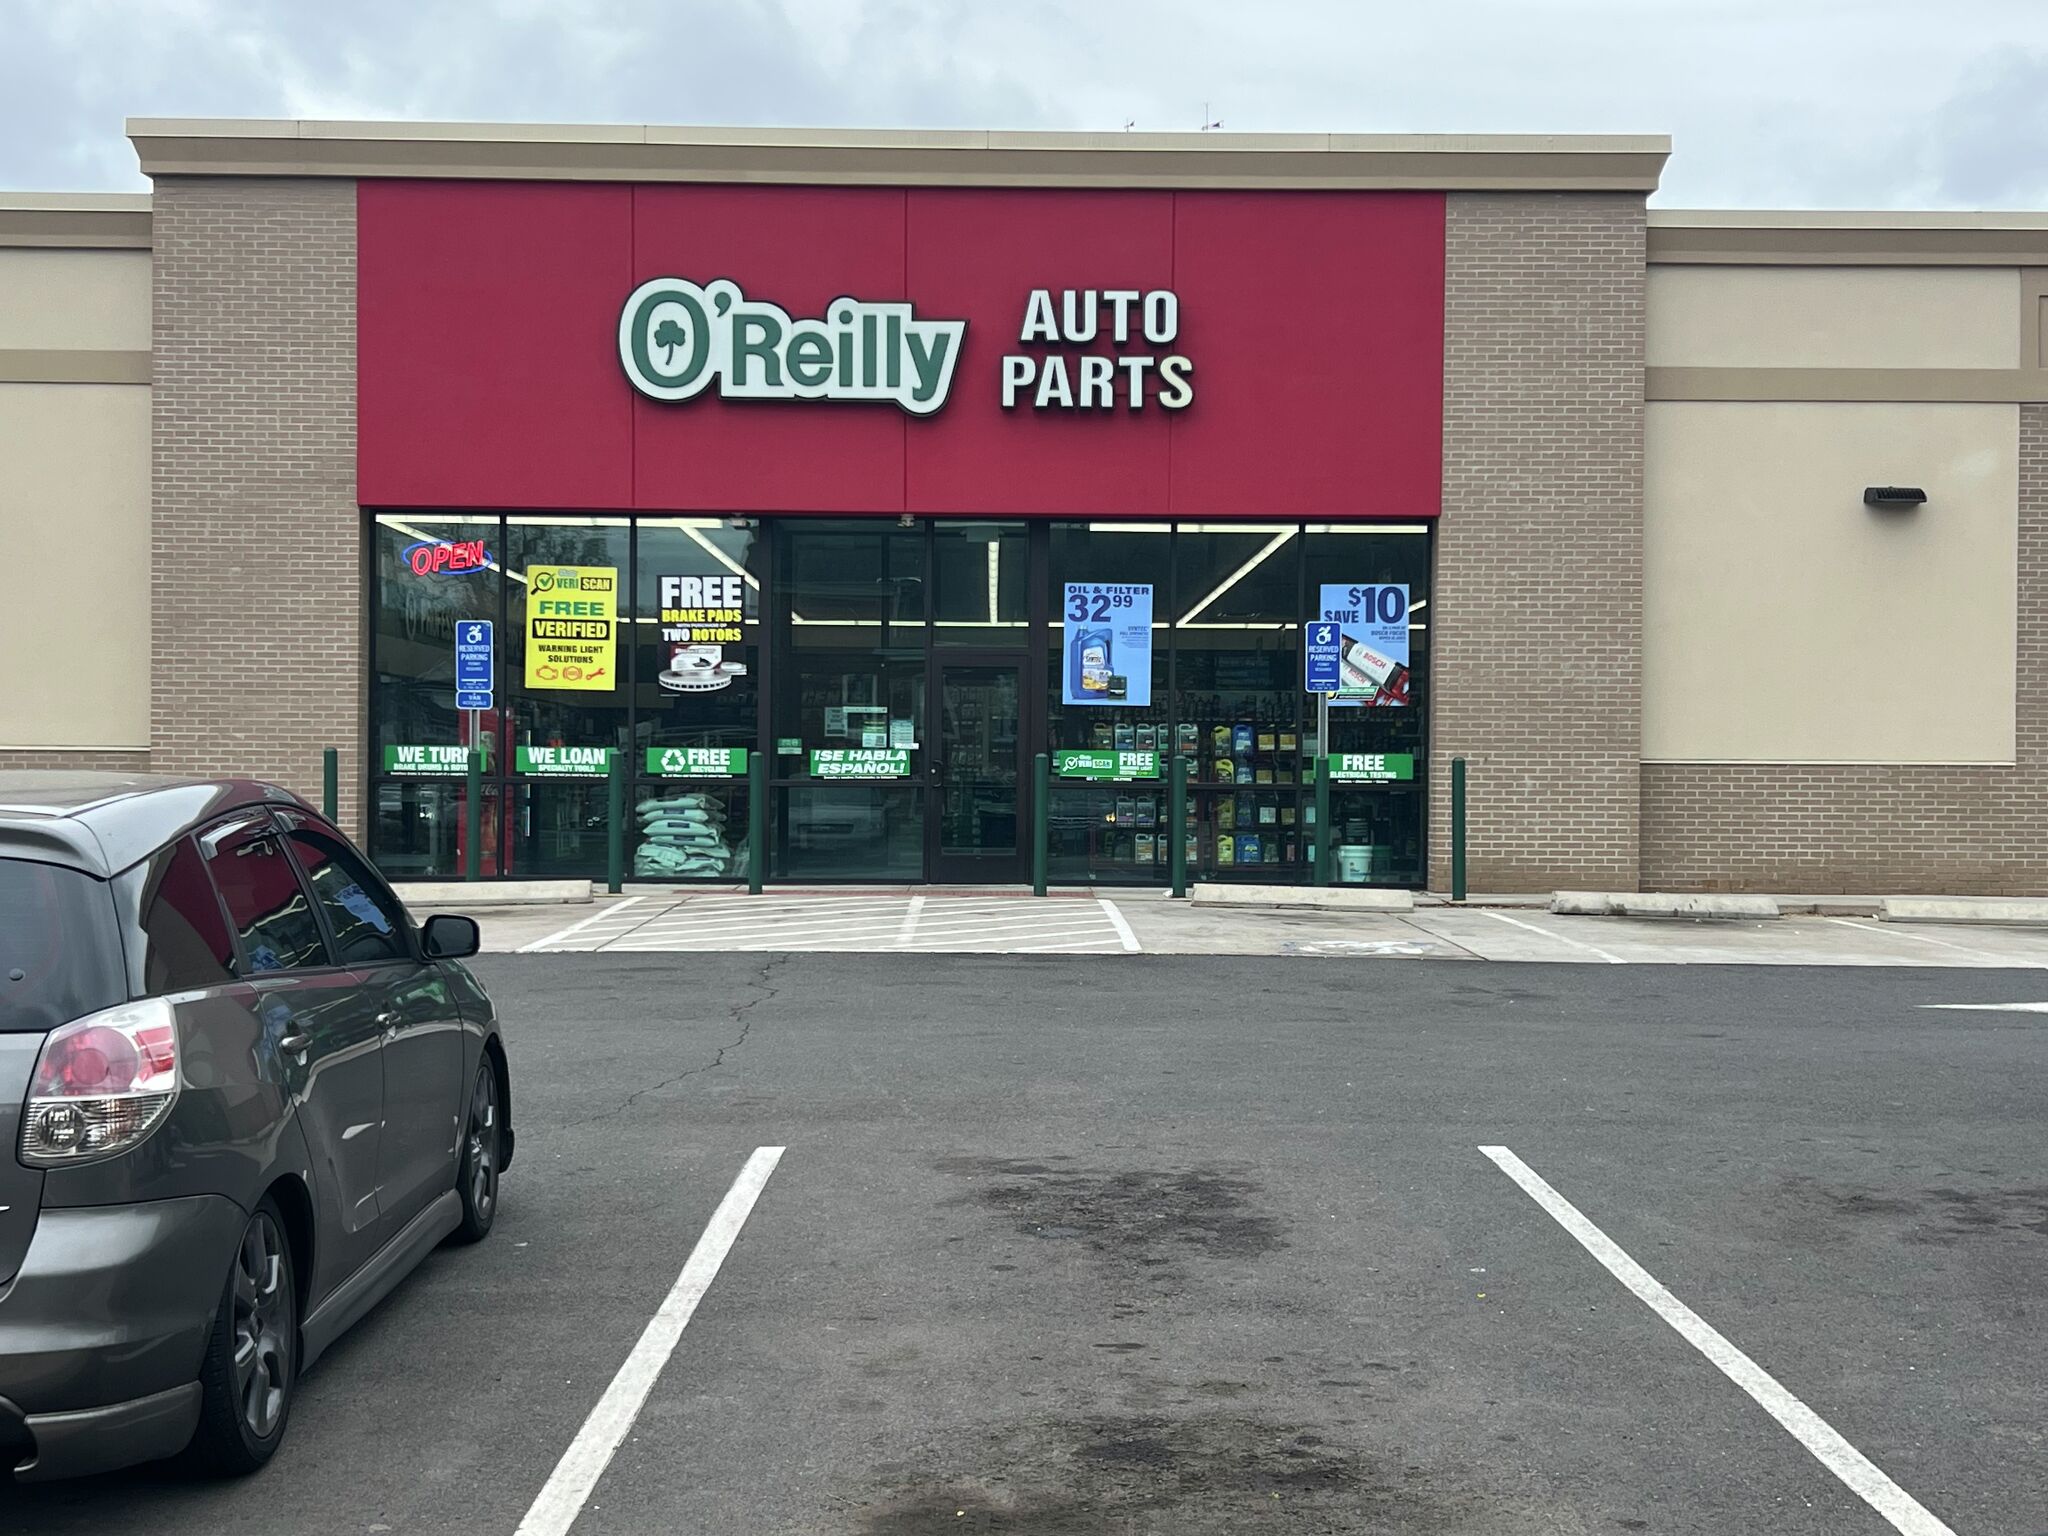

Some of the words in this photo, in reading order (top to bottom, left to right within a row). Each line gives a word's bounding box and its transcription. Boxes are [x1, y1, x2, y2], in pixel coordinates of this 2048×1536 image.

[1020, 289, 1179, 343] AUTO
[629, 288, 952, 402] O'Reilly
[1002, 356, 1194, 409] PARTS
[412, 540, 484, 576] OPEN
[661, 576, 742, 608] FREE
[1106, 586, 1149, 595] FILTER
[540, 601, 604, 616] FREE
[661, 610, 706, 622] BRAKE
[707, 610, 742, 622] PADS
[1324, 610, 1359, 623] SAVE
[534, 620, 607, 638] VERIFIED
[662, 628, 690, 641] TWO
[692, 628, 742, 641] ROTORS
[538, 645, 577, 653] WARNING
[548, 655, 593, 664] SOLUTIONS
[1362, 652, 1387, 669] BOSCH
[397, 746, 424, 763] WE
[528, 747, 555, 763] WE
[560, 747, 606, 764] LOAN
[688, 748, 730, 765] FREE
[848, 750, 908, 761] HABLA
[1120, 753, 1153, 766] FREE
[818, 761, 905, 774] ESPAÑOL!
[1343, 755, 1384, 771] FREE
